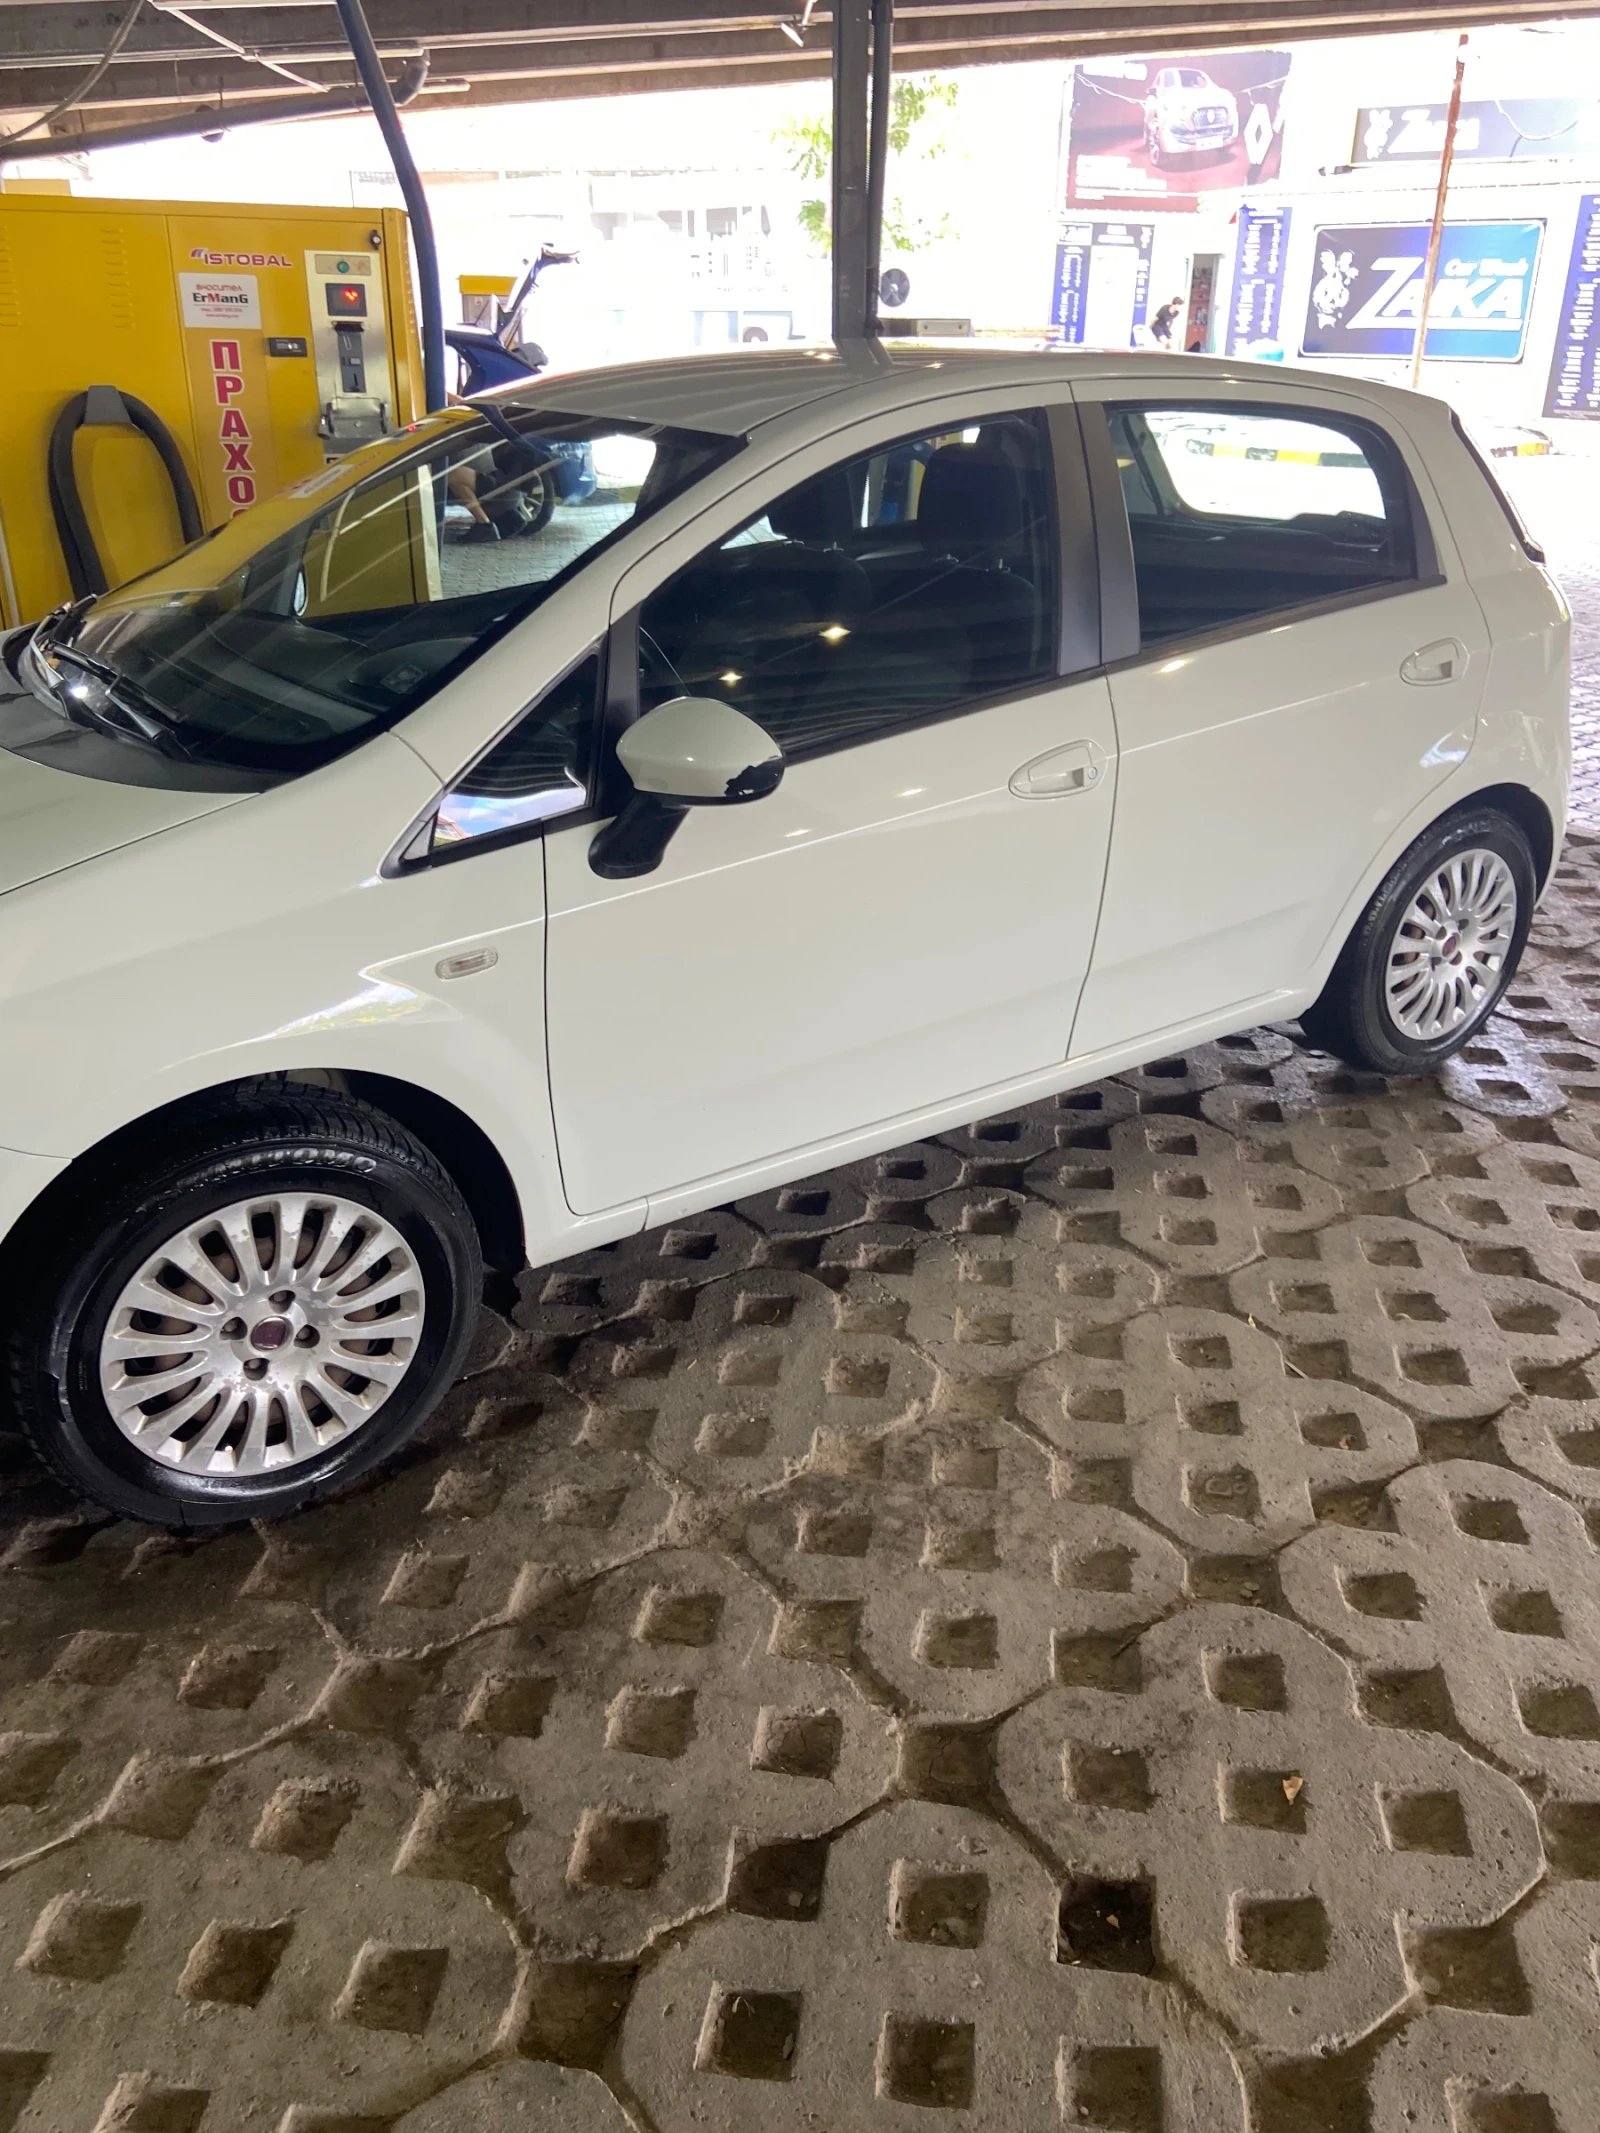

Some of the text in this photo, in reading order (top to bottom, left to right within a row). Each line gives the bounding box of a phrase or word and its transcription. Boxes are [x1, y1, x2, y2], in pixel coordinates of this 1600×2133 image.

[204, 253, 292, 267] ISTOBAL
[192, 292, 249, 304] ErManG
[210, 340, 257, 518] ПРАХО
